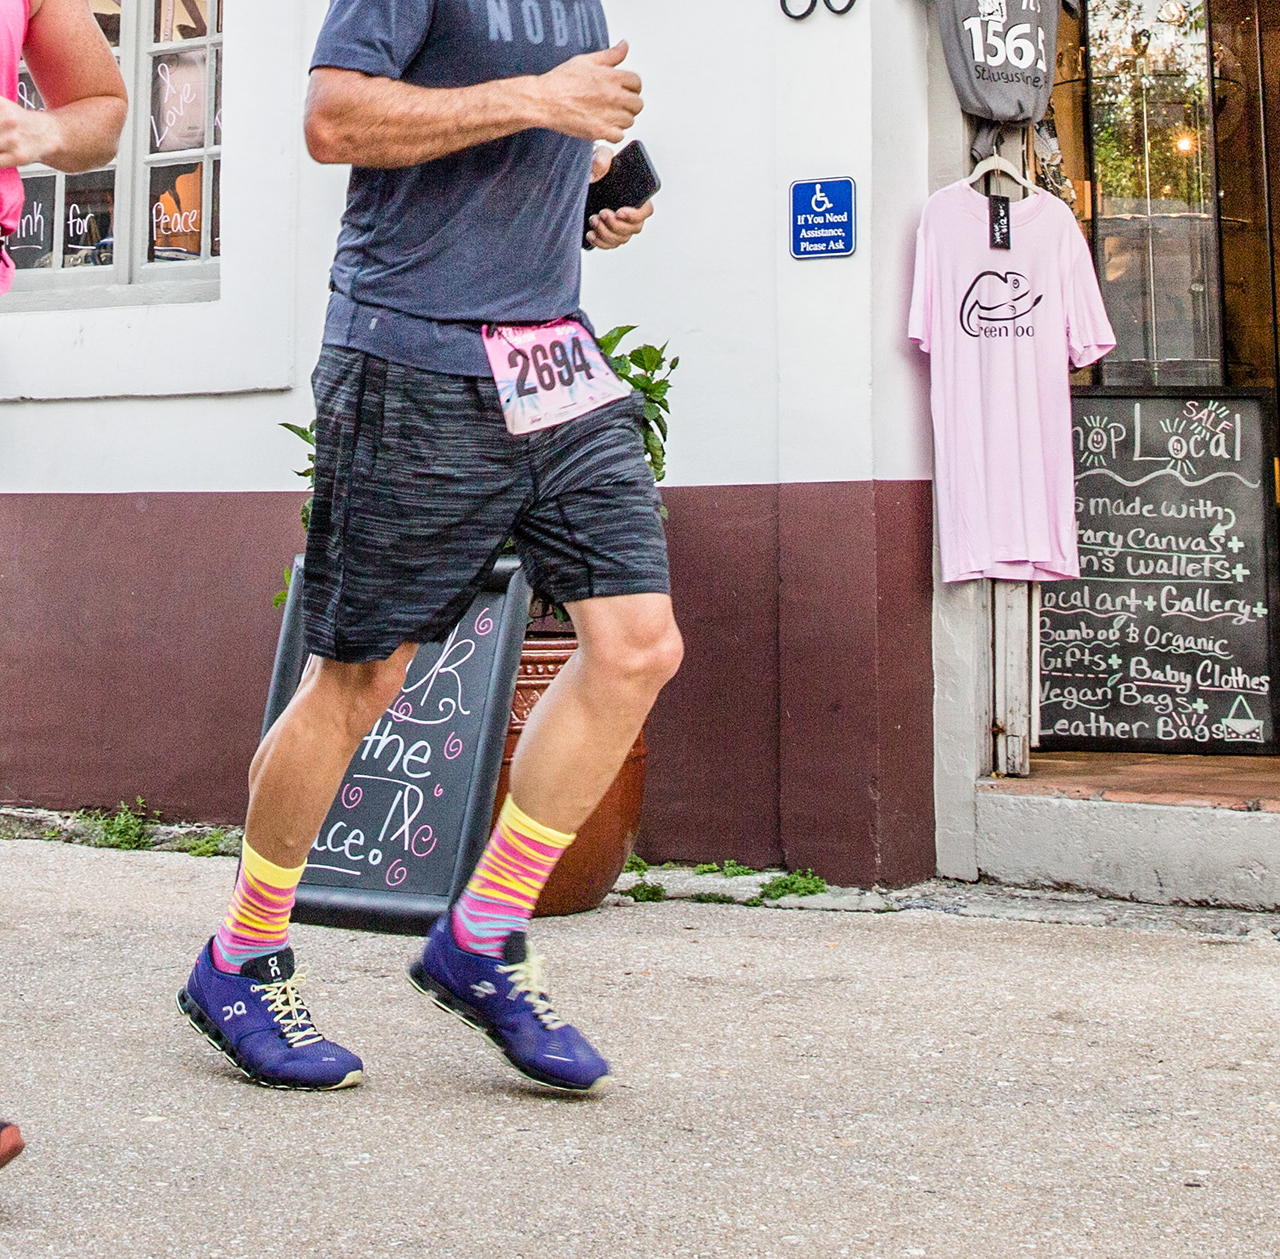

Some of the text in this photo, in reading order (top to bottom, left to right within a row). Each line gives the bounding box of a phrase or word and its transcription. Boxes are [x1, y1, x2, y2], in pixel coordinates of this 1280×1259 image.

[6, 201, 201, 245] ink for Peace
[797, 211, 848, 225] If You Need
[799, 227, 846, 239] Assistance,
[800, 239, 845, 252] Please Ask
[507, 336, 595, 398] 2694
[1182, 400, 1234, 435] SALE
[1089, 496, 1157, 517] made
[1160, 498, 1224, 520] with
[1127, 527, 1226, 554] Canvas
[1095, 588, 1142, 611] art
[1160, 585, 1252, 625] Gallery
[1144, 625, 1230, 656] Organic
[1040, 647, 1108, 671] Gifts
[1129, 656, 1193, 694] Baby
[1195, 659, 1271, 692] Clothes
[1118, 683, 1193, 714] Bags
[1157, 716, 1225, 742] Bags
[360, 717, 432, 779] the
